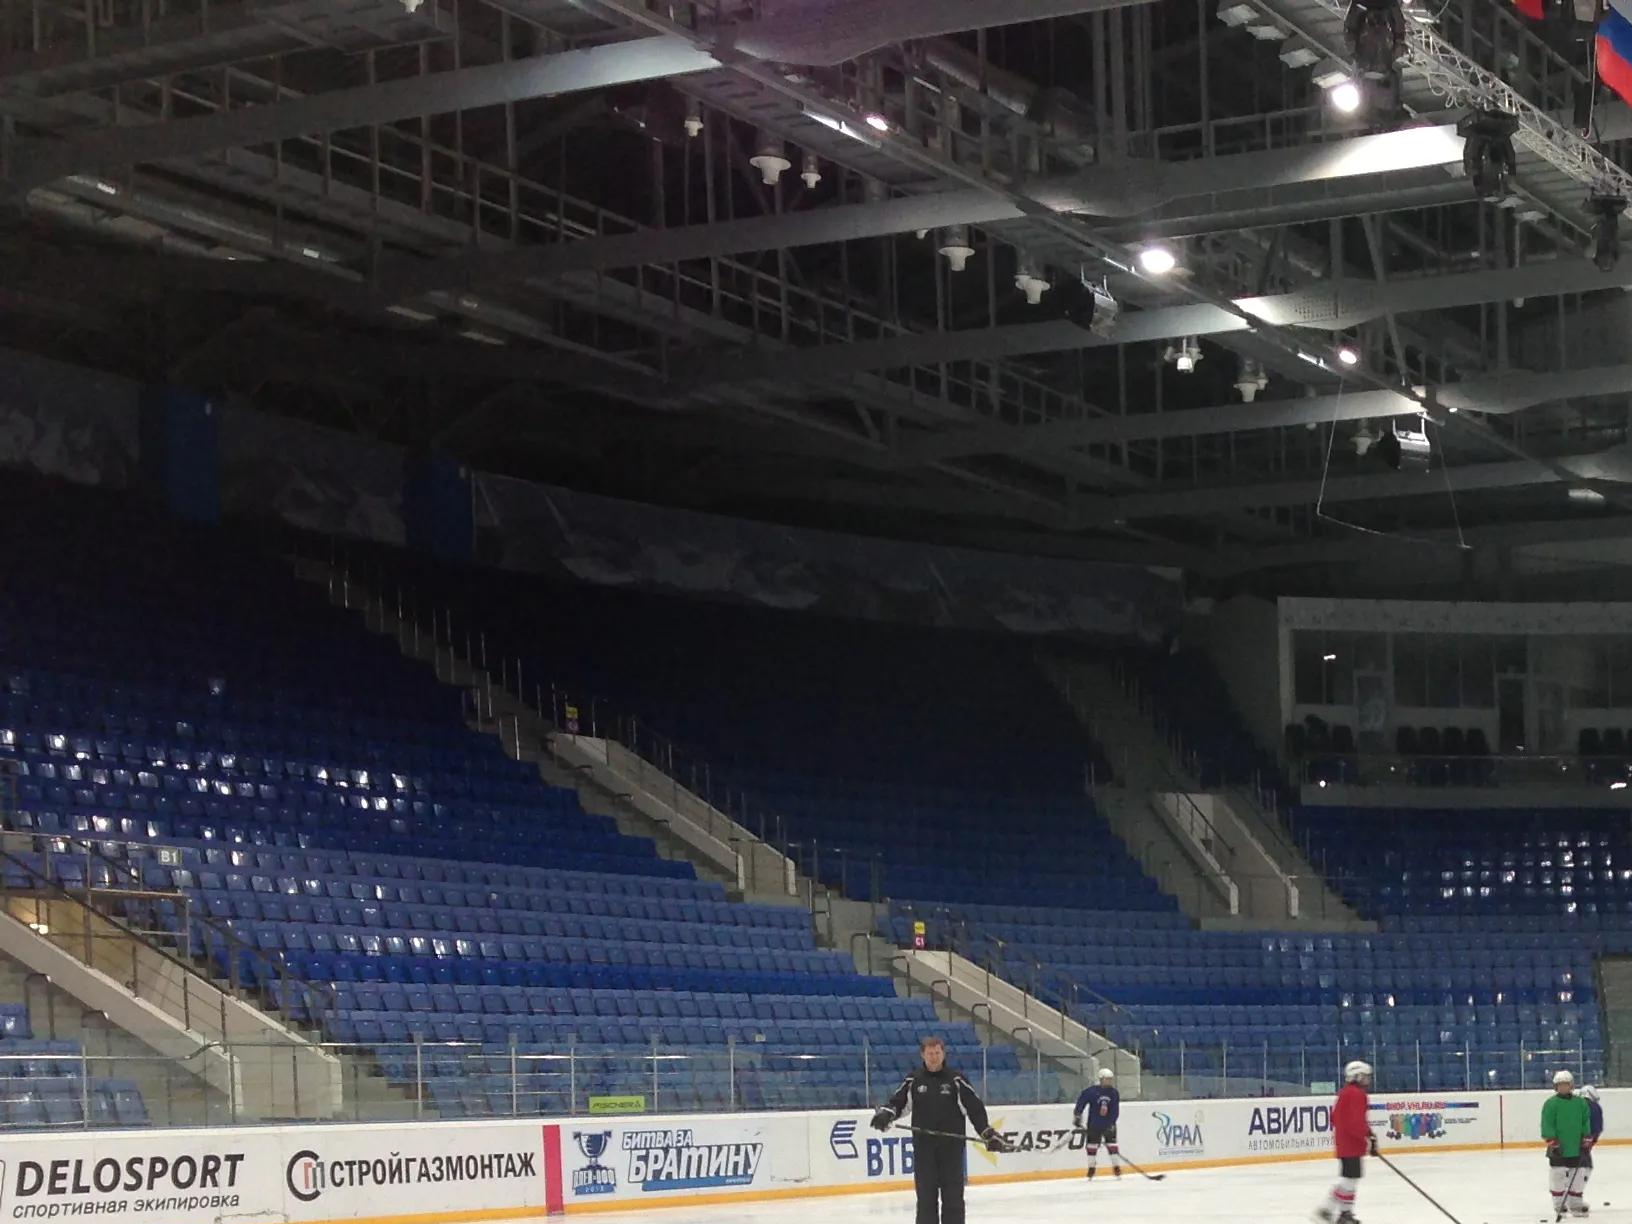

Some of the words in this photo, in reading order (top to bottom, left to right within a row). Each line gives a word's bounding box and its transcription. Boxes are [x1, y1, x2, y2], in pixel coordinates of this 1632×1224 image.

[623, 1131, 672, 1149] БИТВА
[674, 1130, 693, 1147] ЗА
[1001, 1129, 1087, 1152] EASTO
[1162, 1125, 1203, 1146] УРАЛ
[15, 1153, 245, 1197] DELOSPORT
[329, 1151, 537, 1188] СТРОЙГАЗМОНТАЖ
[629, 1144, 762, 1183] БРАТИНУ
[13, 1199, 127, 1219] спортивная
[133, 1193, 240, 1212] экипировка
